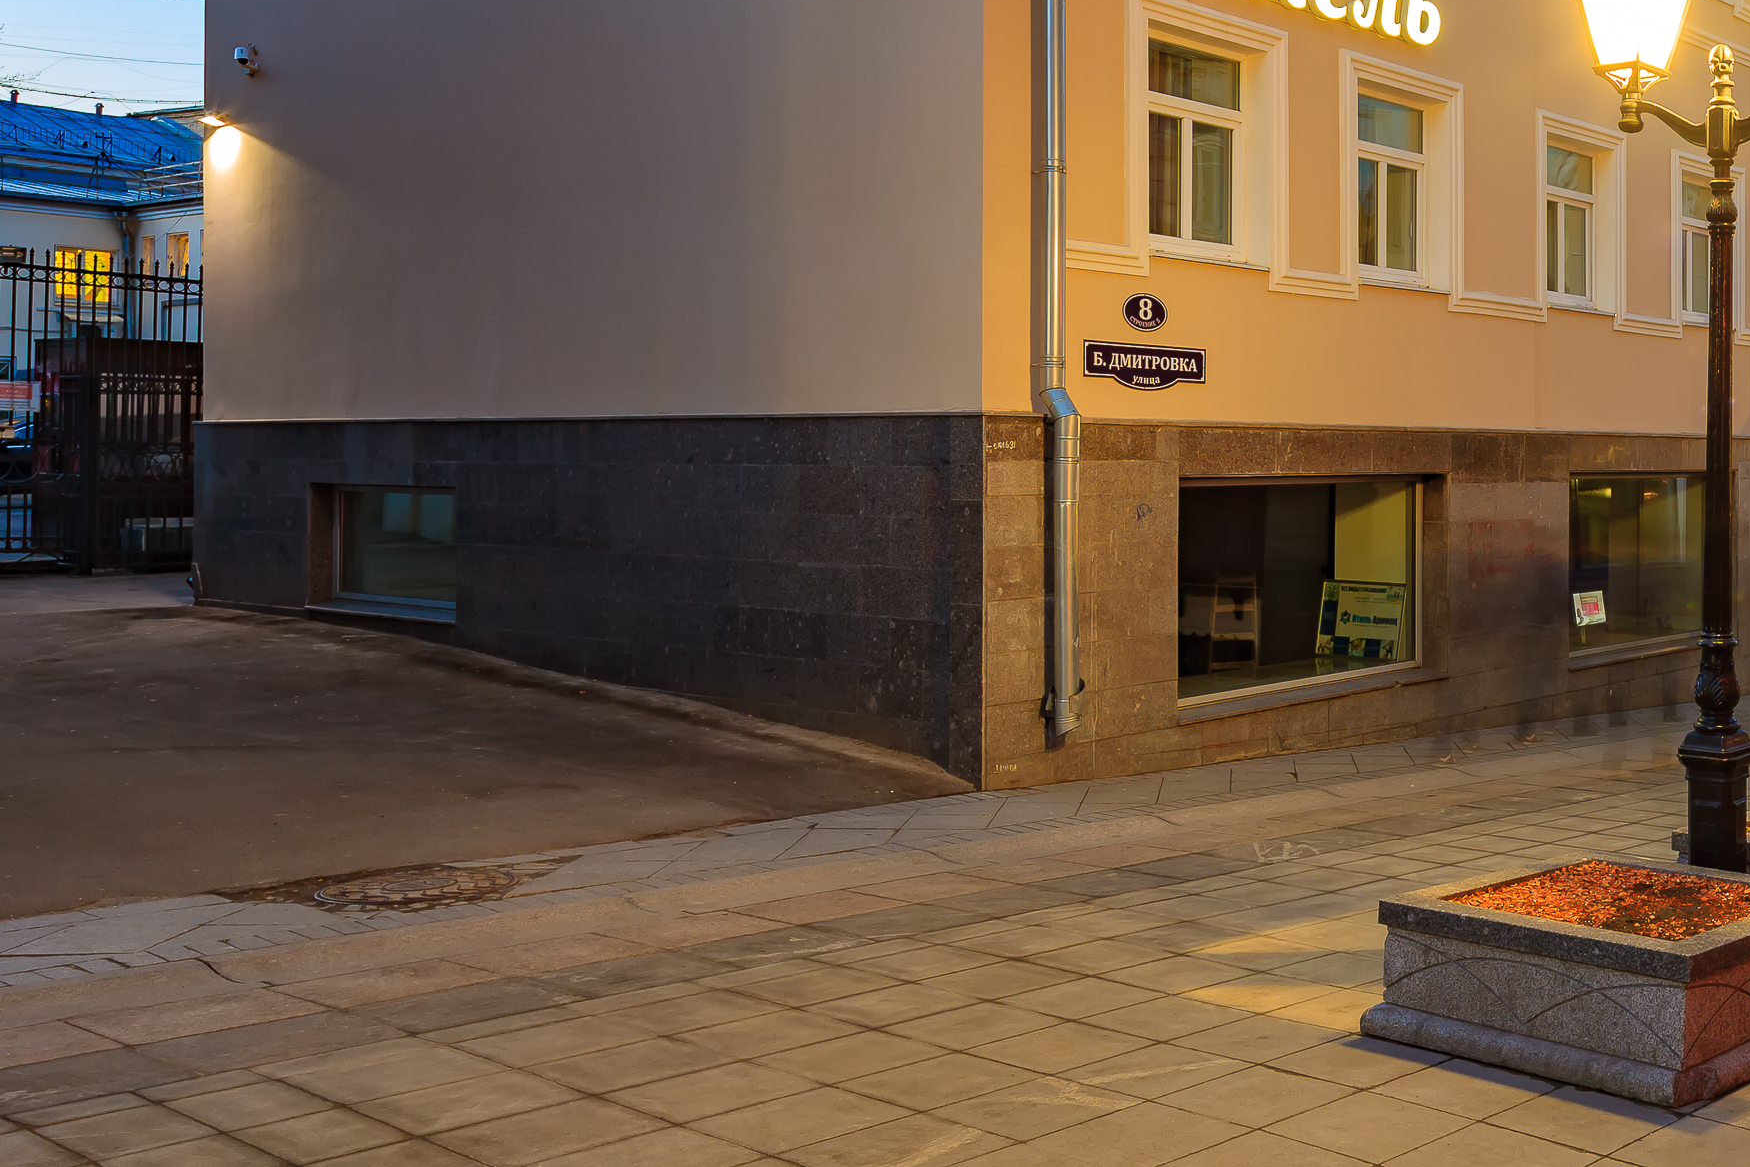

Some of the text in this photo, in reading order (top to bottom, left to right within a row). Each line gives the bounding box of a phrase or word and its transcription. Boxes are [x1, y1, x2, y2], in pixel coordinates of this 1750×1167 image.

[1139, 298, 1153, 321] 8
[1129, 315, 1157, 328] СТРОЕНИЕ
[1093, 351, 1198, 373] Б. ДМИТРОВКА
[1132, 374, 1161, 385] улица
